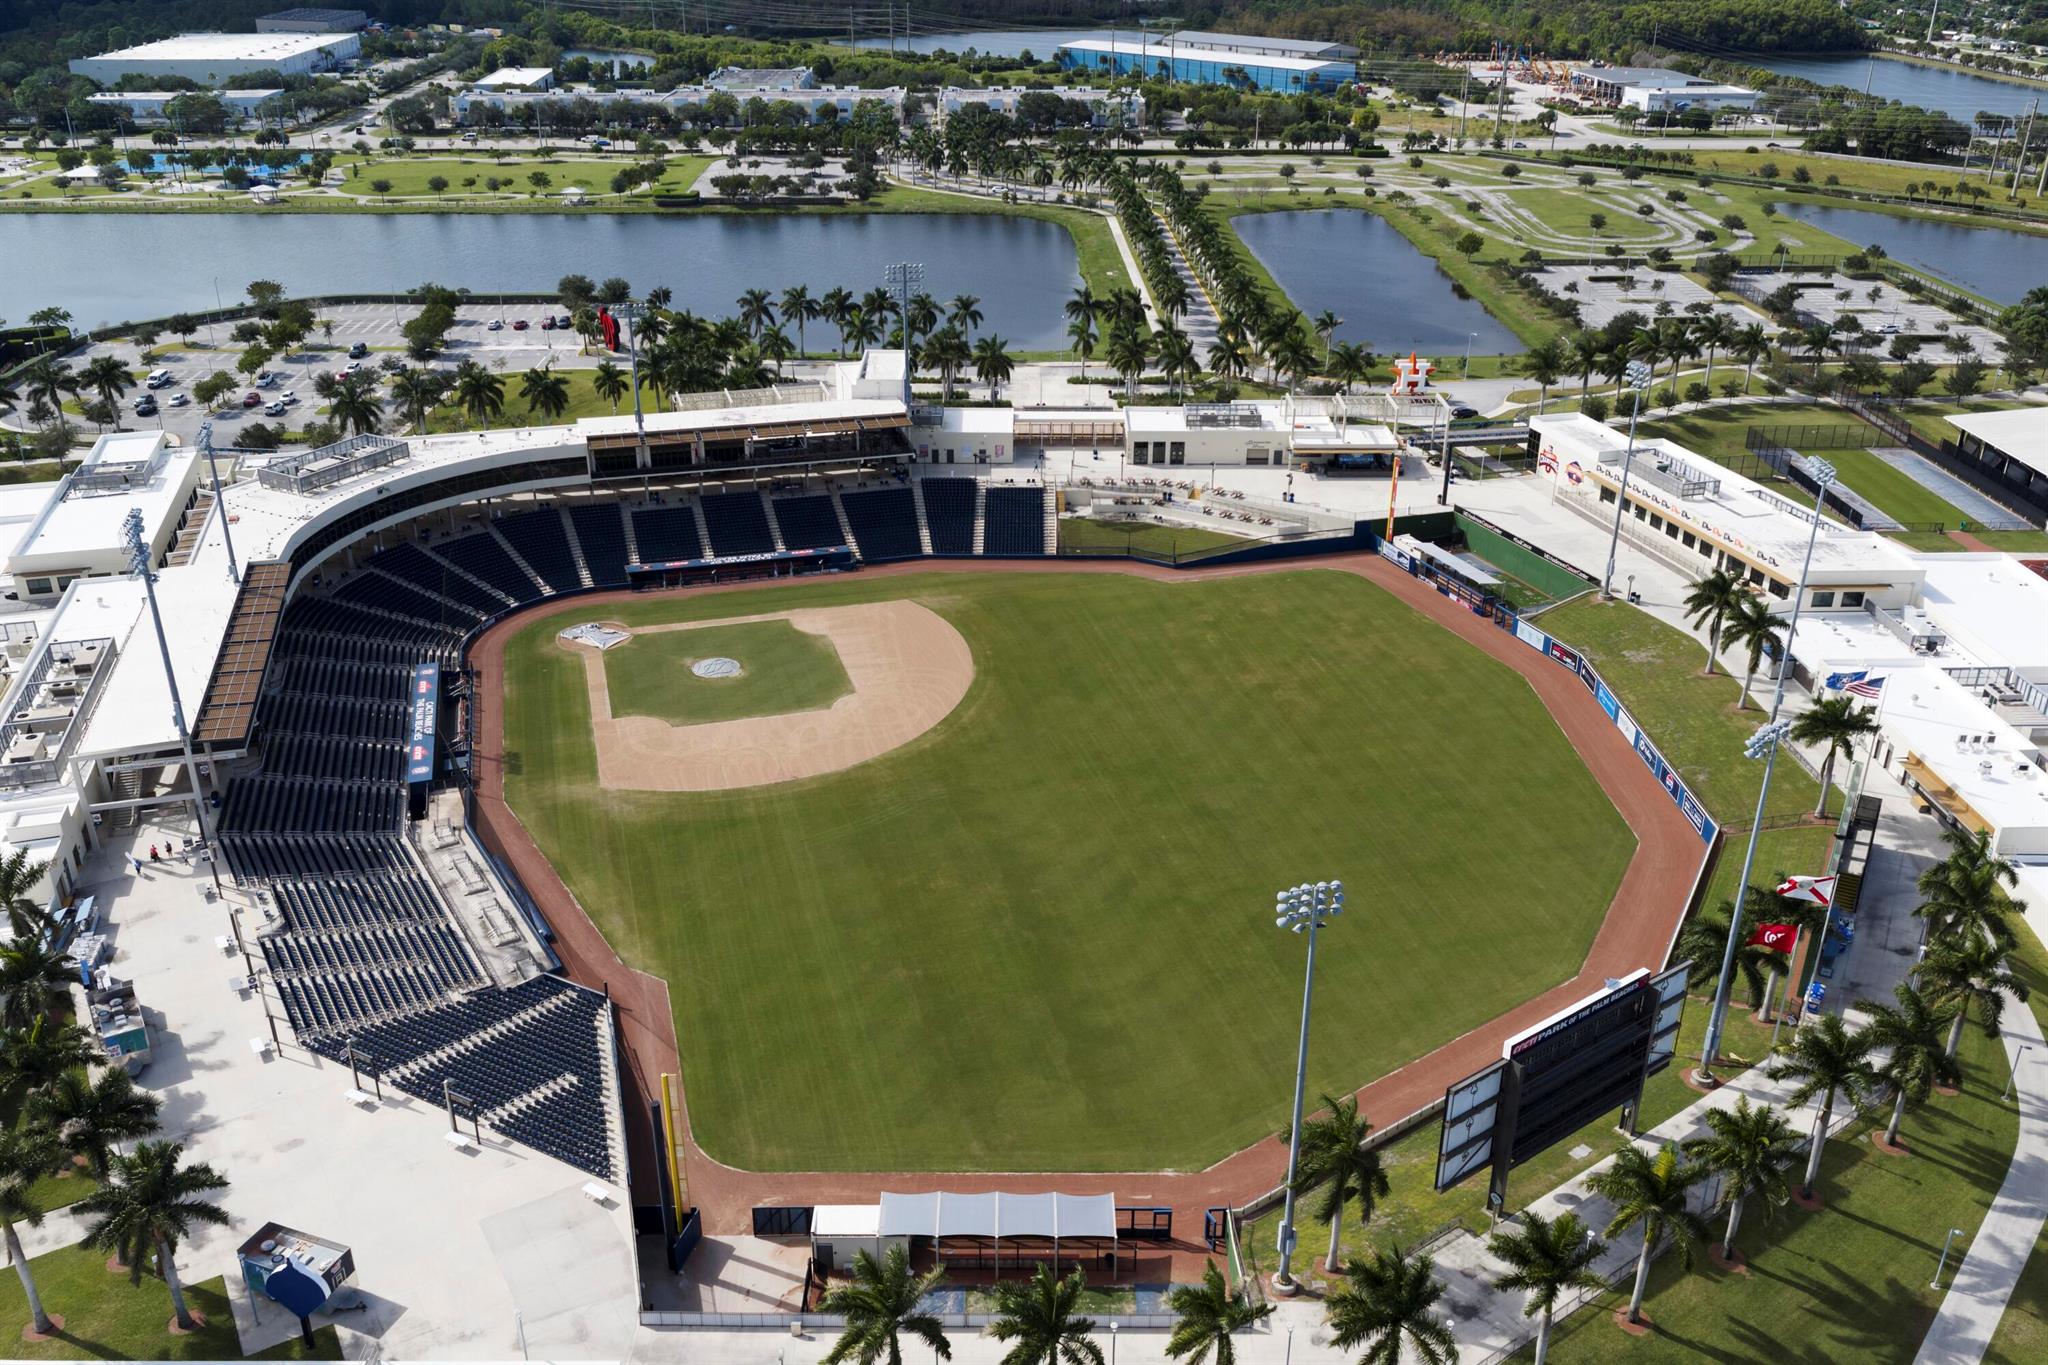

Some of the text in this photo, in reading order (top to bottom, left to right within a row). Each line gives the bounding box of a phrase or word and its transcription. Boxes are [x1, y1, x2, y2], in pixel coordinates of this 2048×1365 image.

[1537, 1019, 1570, 1041] PARK
[1568, 1015, 1578, 1026] OF
[1578, 1008, 1591, 1020] THE
[1591, 998, 1611, 1013] PALM
[1610, 981, 1640, 1002] BEACHES
